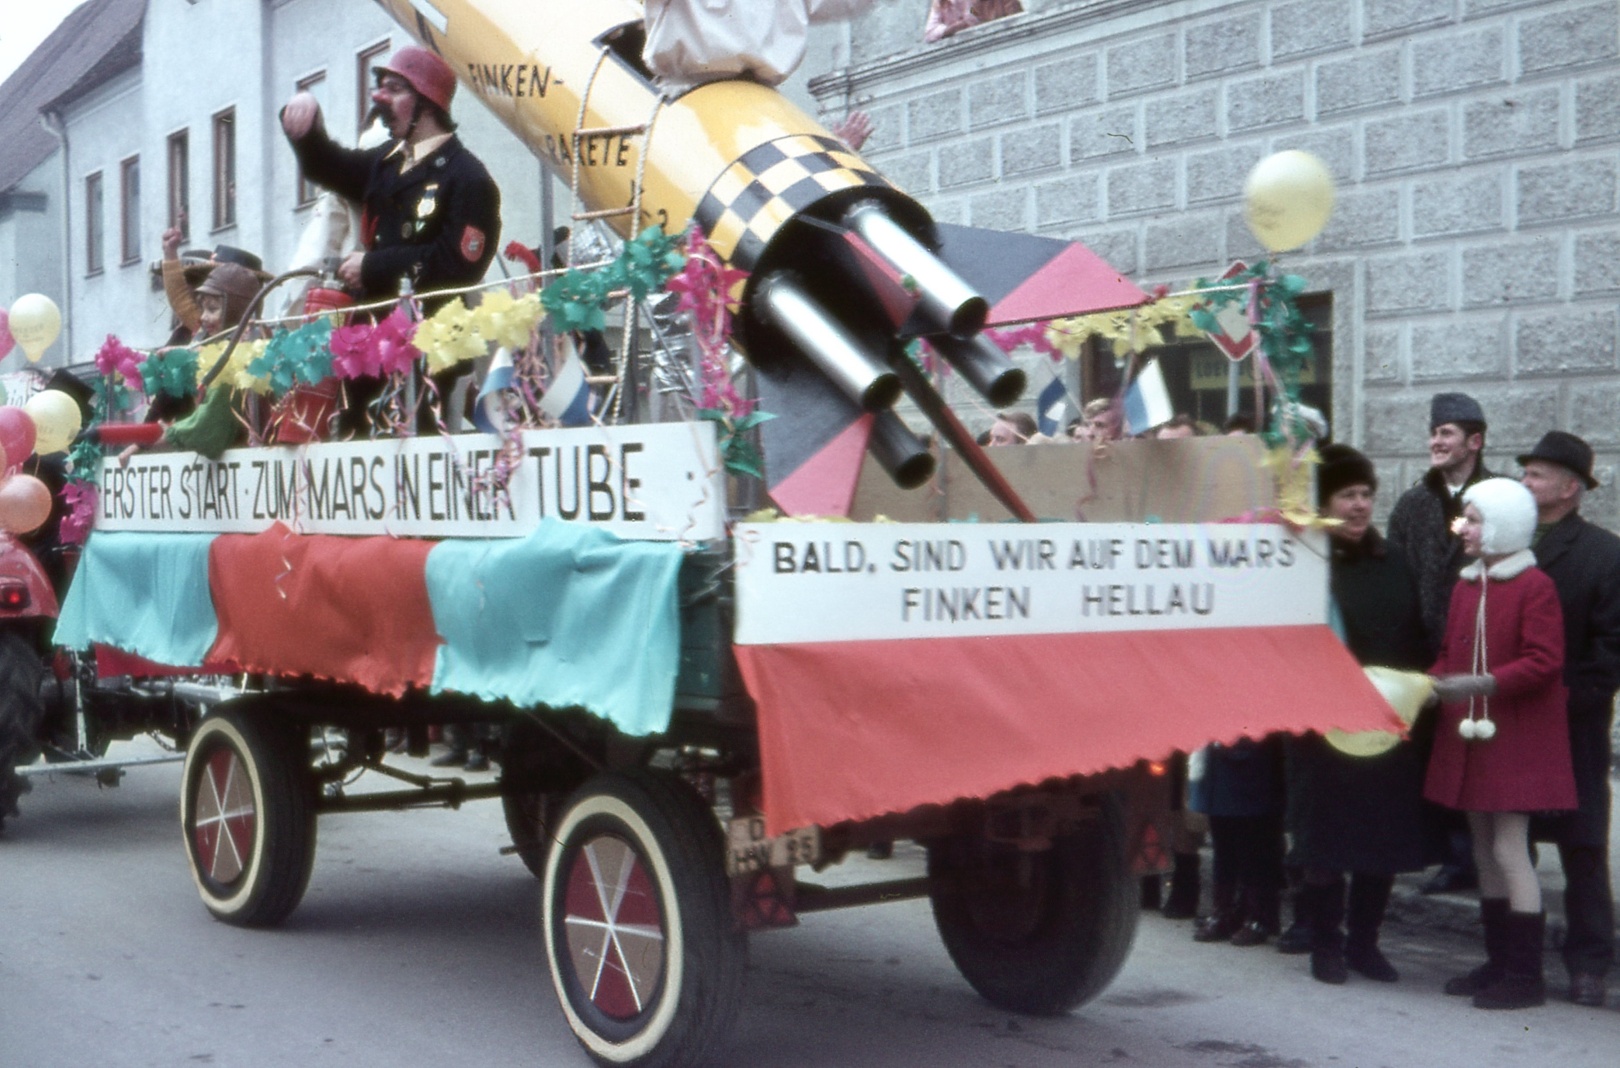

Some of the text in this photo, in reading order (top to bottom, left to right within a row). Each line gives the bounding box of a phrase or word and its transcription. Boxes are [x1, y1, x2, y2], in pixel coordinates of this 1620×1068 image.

[103, 442, 646, 522] ERSTER START ZUM MARS IN EINER TUBE
[889, 539, 967, 572] SIND
[988, 539, 1057, 571] WIR
[1066, 538, 1124, 570] AUF
[1134, 538, 1197, 569] DEM
[1206, 538, 1297, 568] MARS
[900, 582, 1216, 622] FINKEN HELLAU
